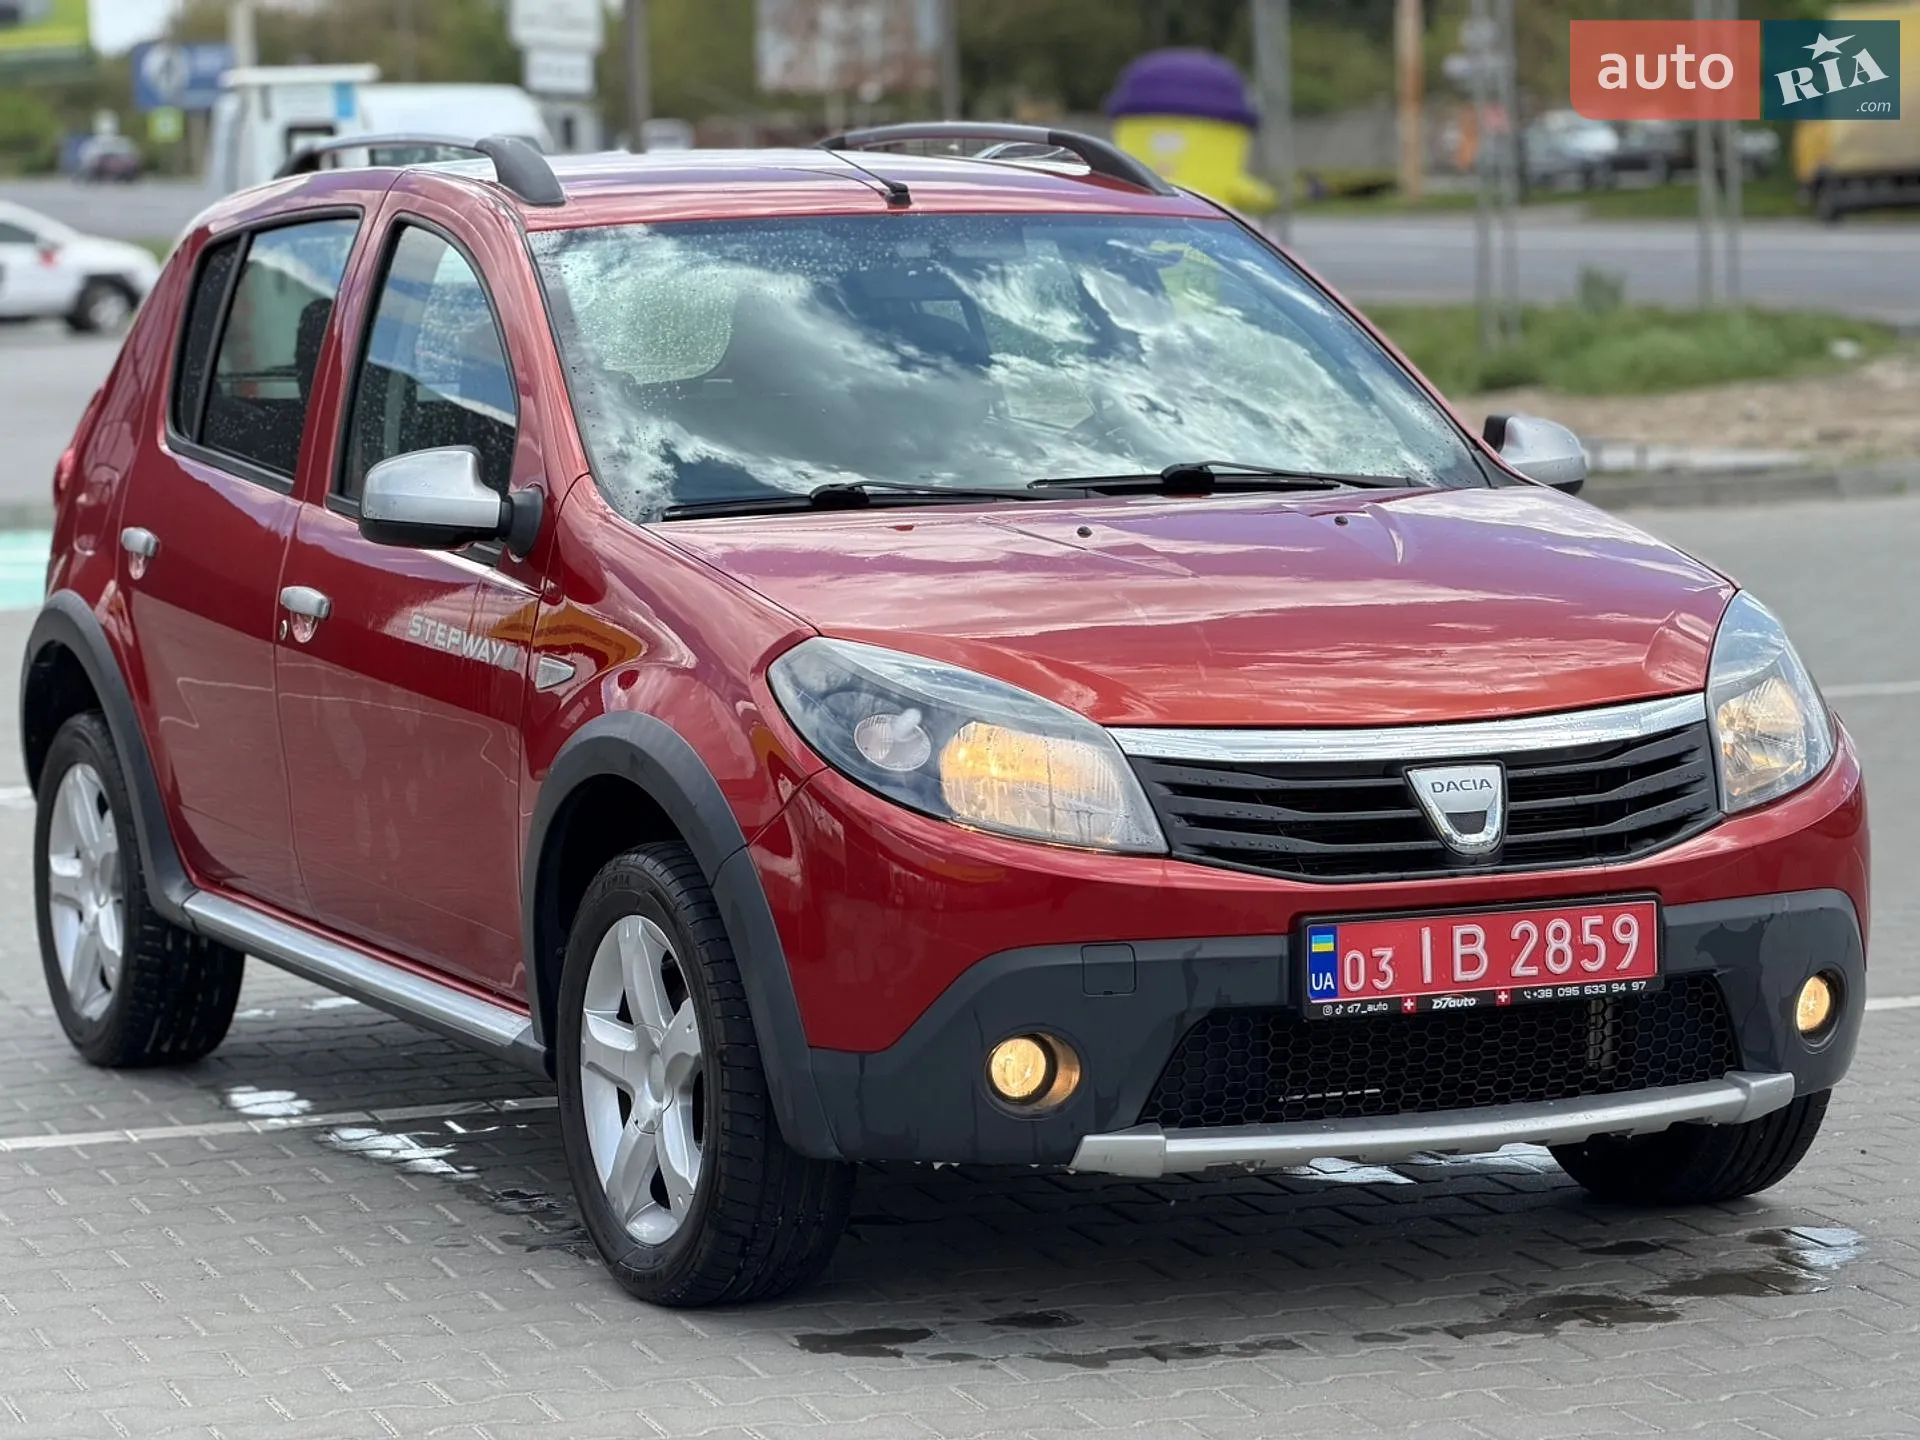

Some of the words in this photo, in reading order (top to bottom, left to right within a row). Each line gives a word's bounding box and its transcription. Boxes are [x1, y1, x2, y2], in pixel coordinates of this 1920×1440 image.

[408, 613, 505, 665] STEPWAY
[1430, 778, 1493, 793] DACIA
[1343, 947, 1395, 992] 03
[1420, 923, 1489, 984] IB
[1510, 913, 1640, 977] 2859
[1311, 972, 1335, 991] UA
[1557, 986, 1580, 997] 095
[1584, 984, 1607, 995] 633
[1611, 983, 1627, 993] 94
[1631, 980, 1647, 991] 97
[1346, 1001, 1389, 1014] d7_auto
